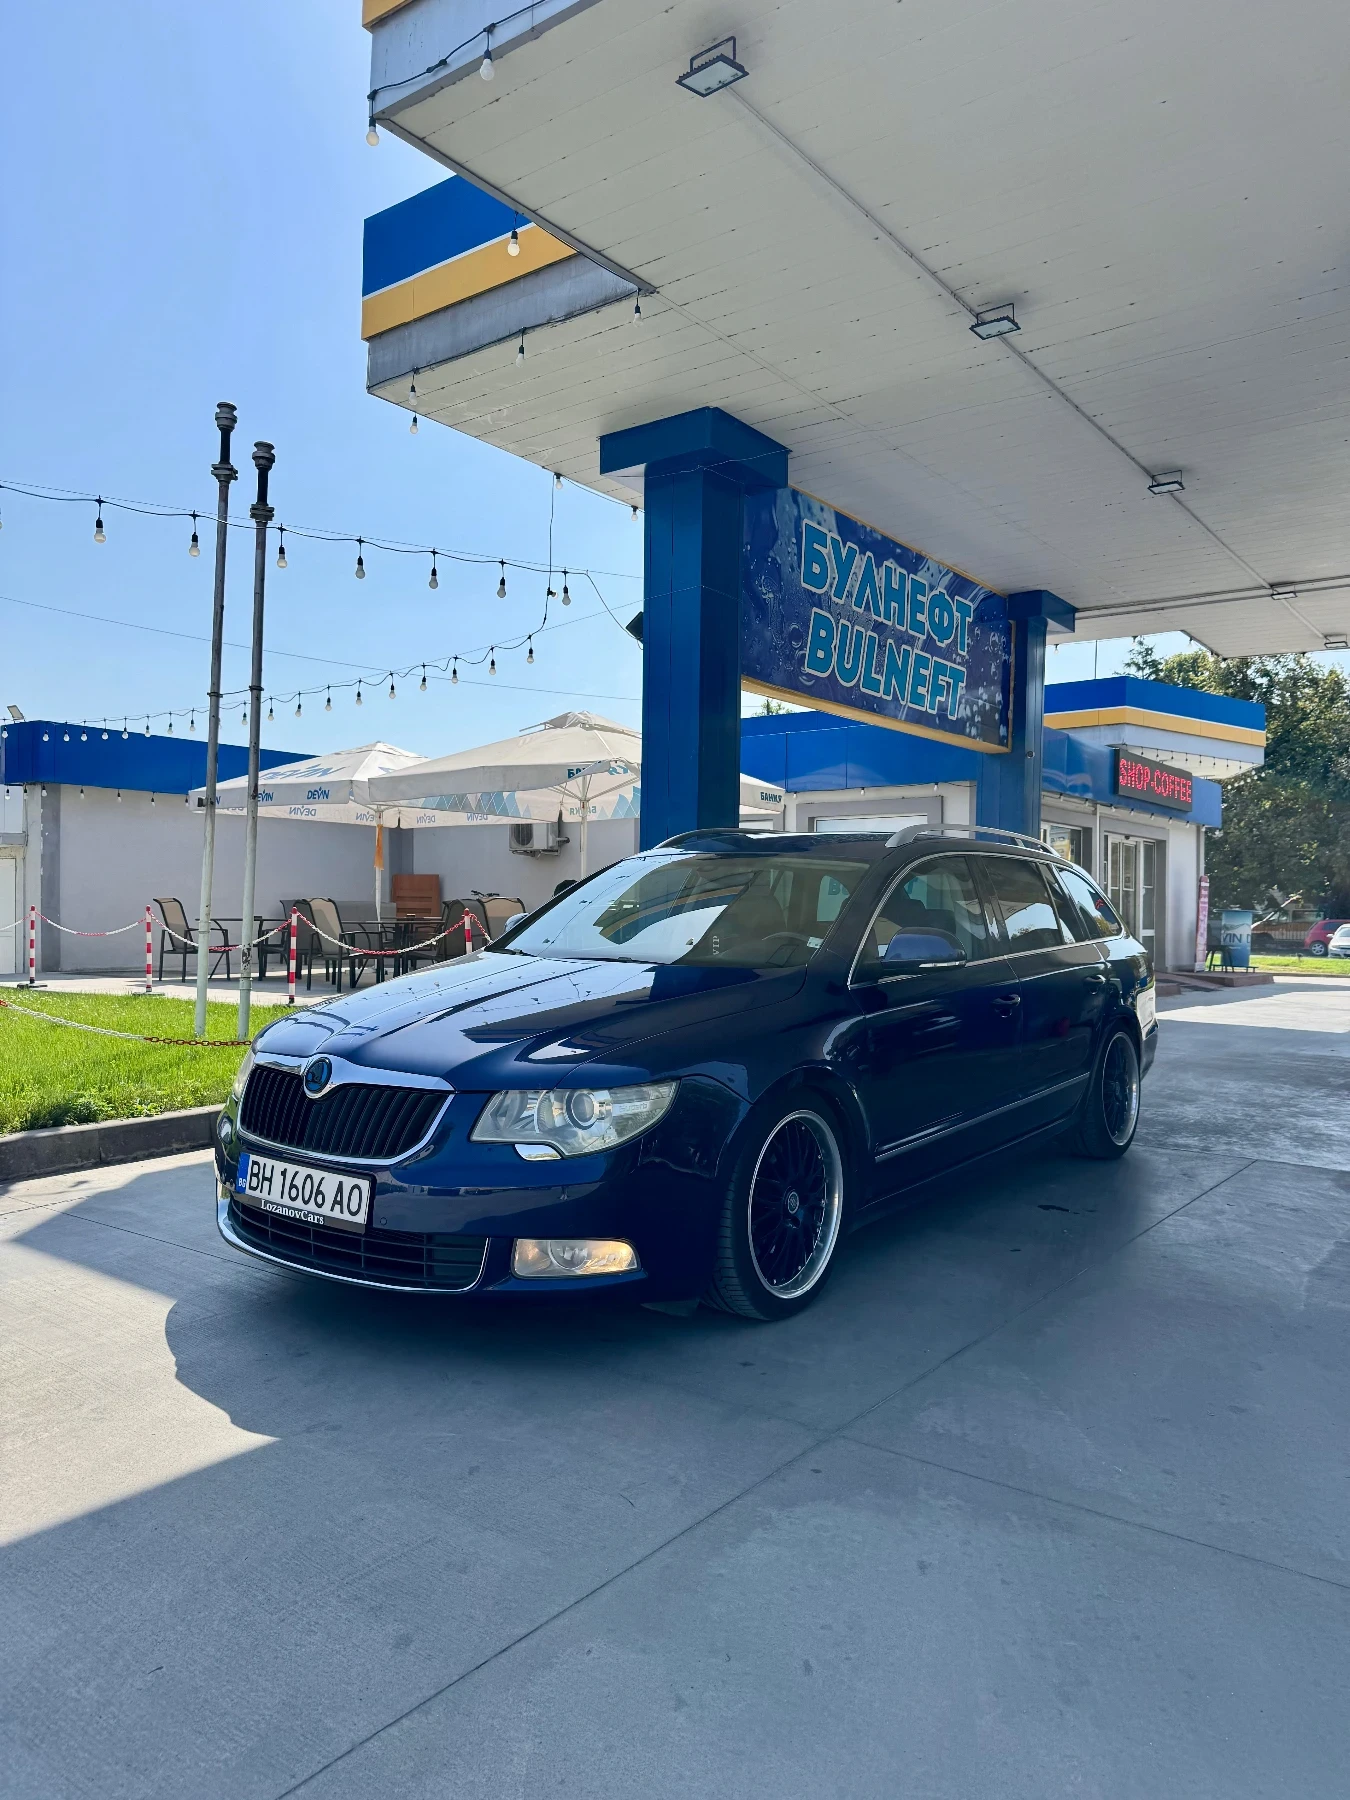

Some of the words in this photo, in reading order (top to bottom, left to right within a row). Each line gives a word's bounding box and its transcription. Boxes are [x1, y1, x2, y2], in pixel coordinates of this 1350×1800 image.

[802, 519, 973, 655] БУЛНЕФТ
[805, 607, 967, 720] BULNEFT
[257, 789, 274, 802] EVIN
[306, 787, 330, 800] DEVIN
[1119, 758, 1192, 803] SHOP-COFFEE
[238, 1176, 247, 1188] BG
[248, 1159, 275, 1196] BH
[280, 1167, 326, 1209] 1606
[329, 1180, 363, 1217] AO
[260, 1199, 325, 1225] LozanovCars
